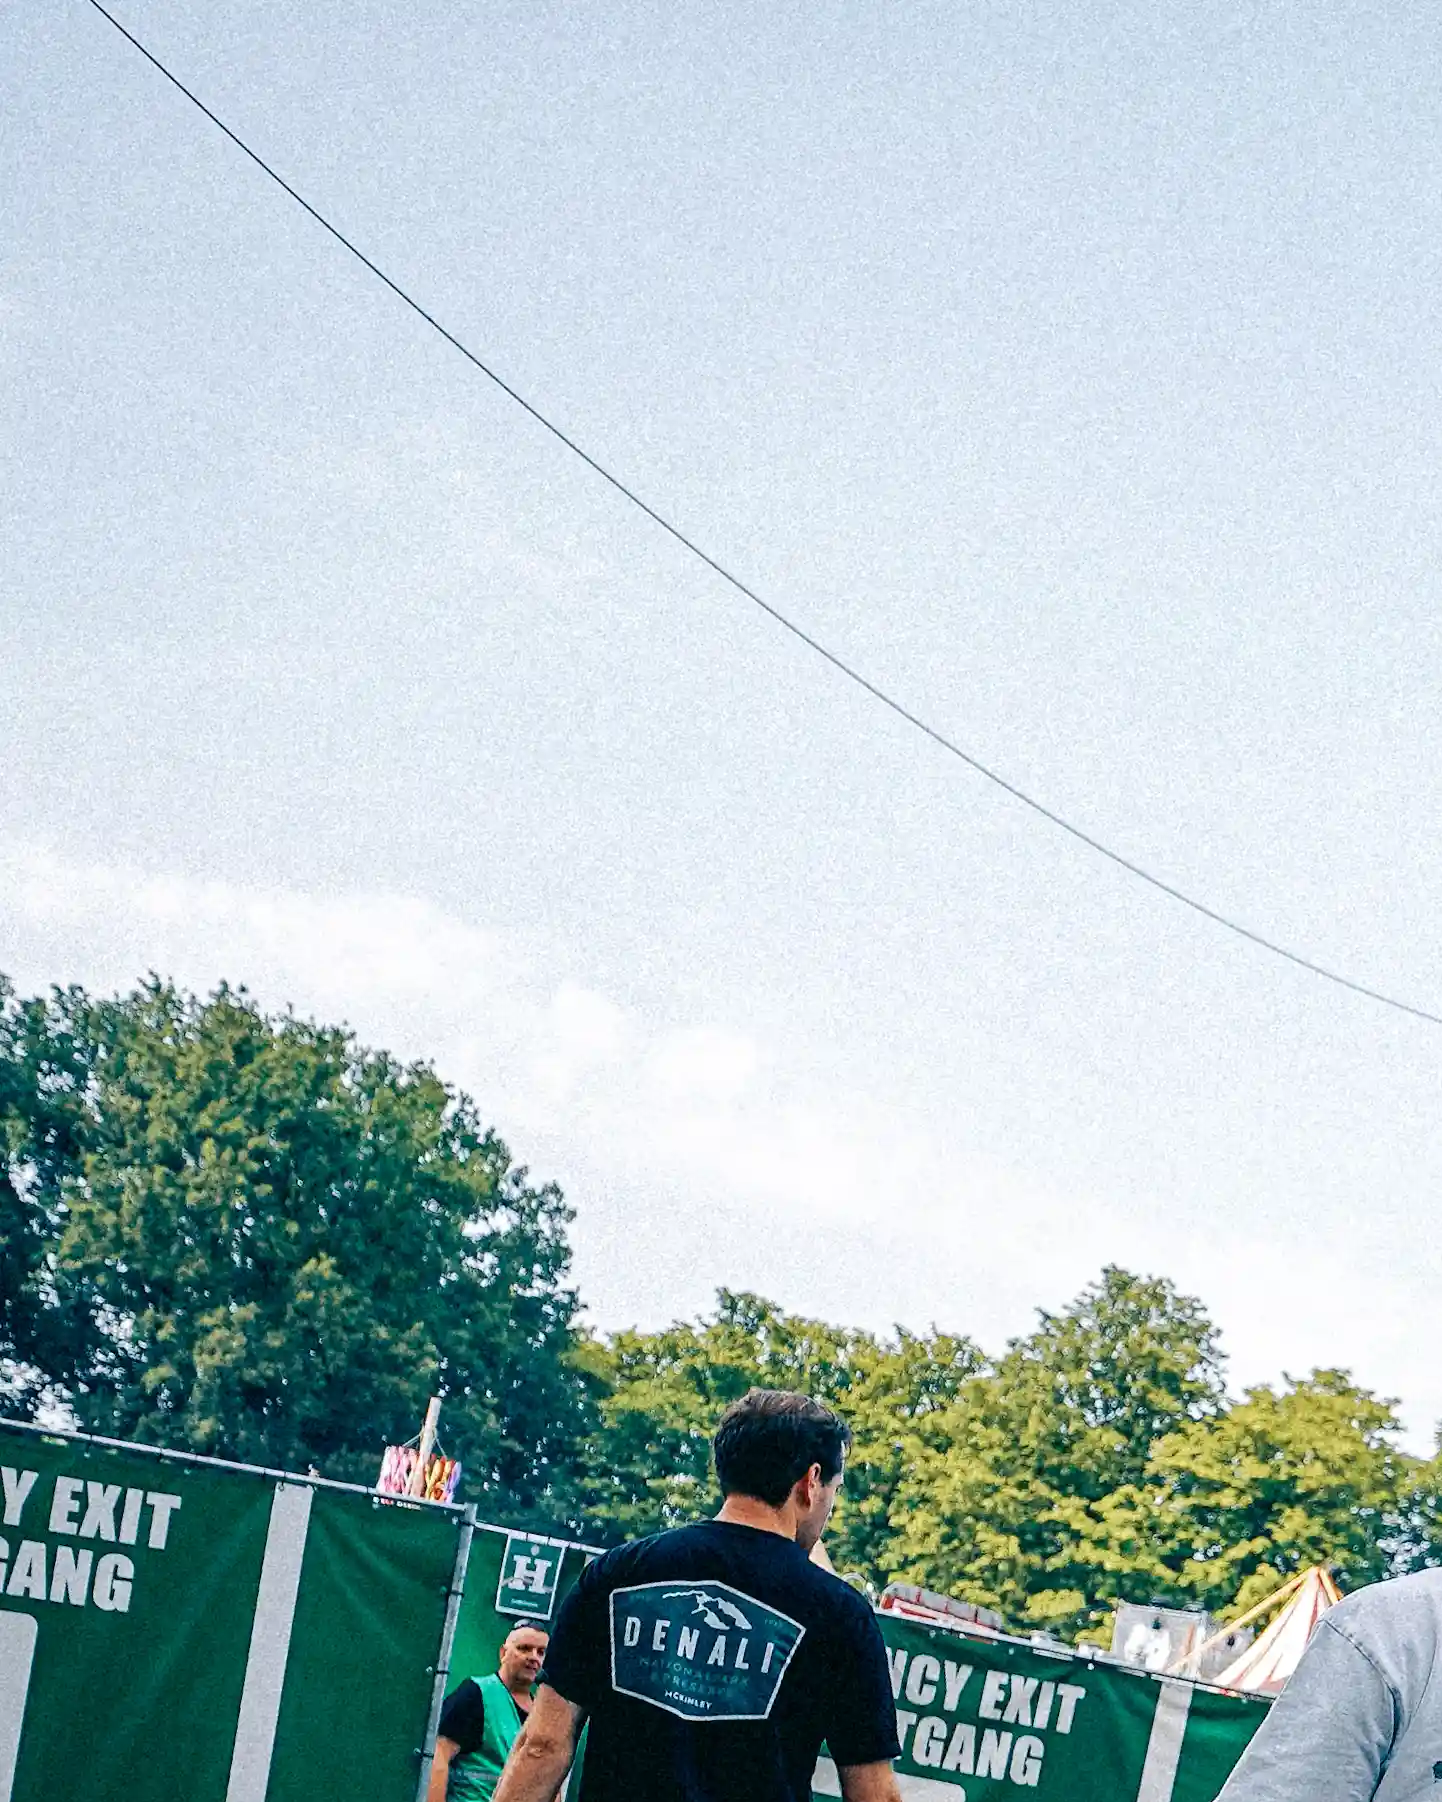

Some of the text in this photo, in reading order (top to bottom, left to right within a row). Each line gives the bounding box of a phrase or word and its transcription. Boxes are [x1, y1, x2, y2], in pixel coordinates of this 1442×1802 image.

[49, 1475, 182, 1550] EXIT
[0, 1535, 135, 1613] ANG
[623, 1616, 775, 1674] DENALI
[979, 1669, 1087, 1735] EXIT
